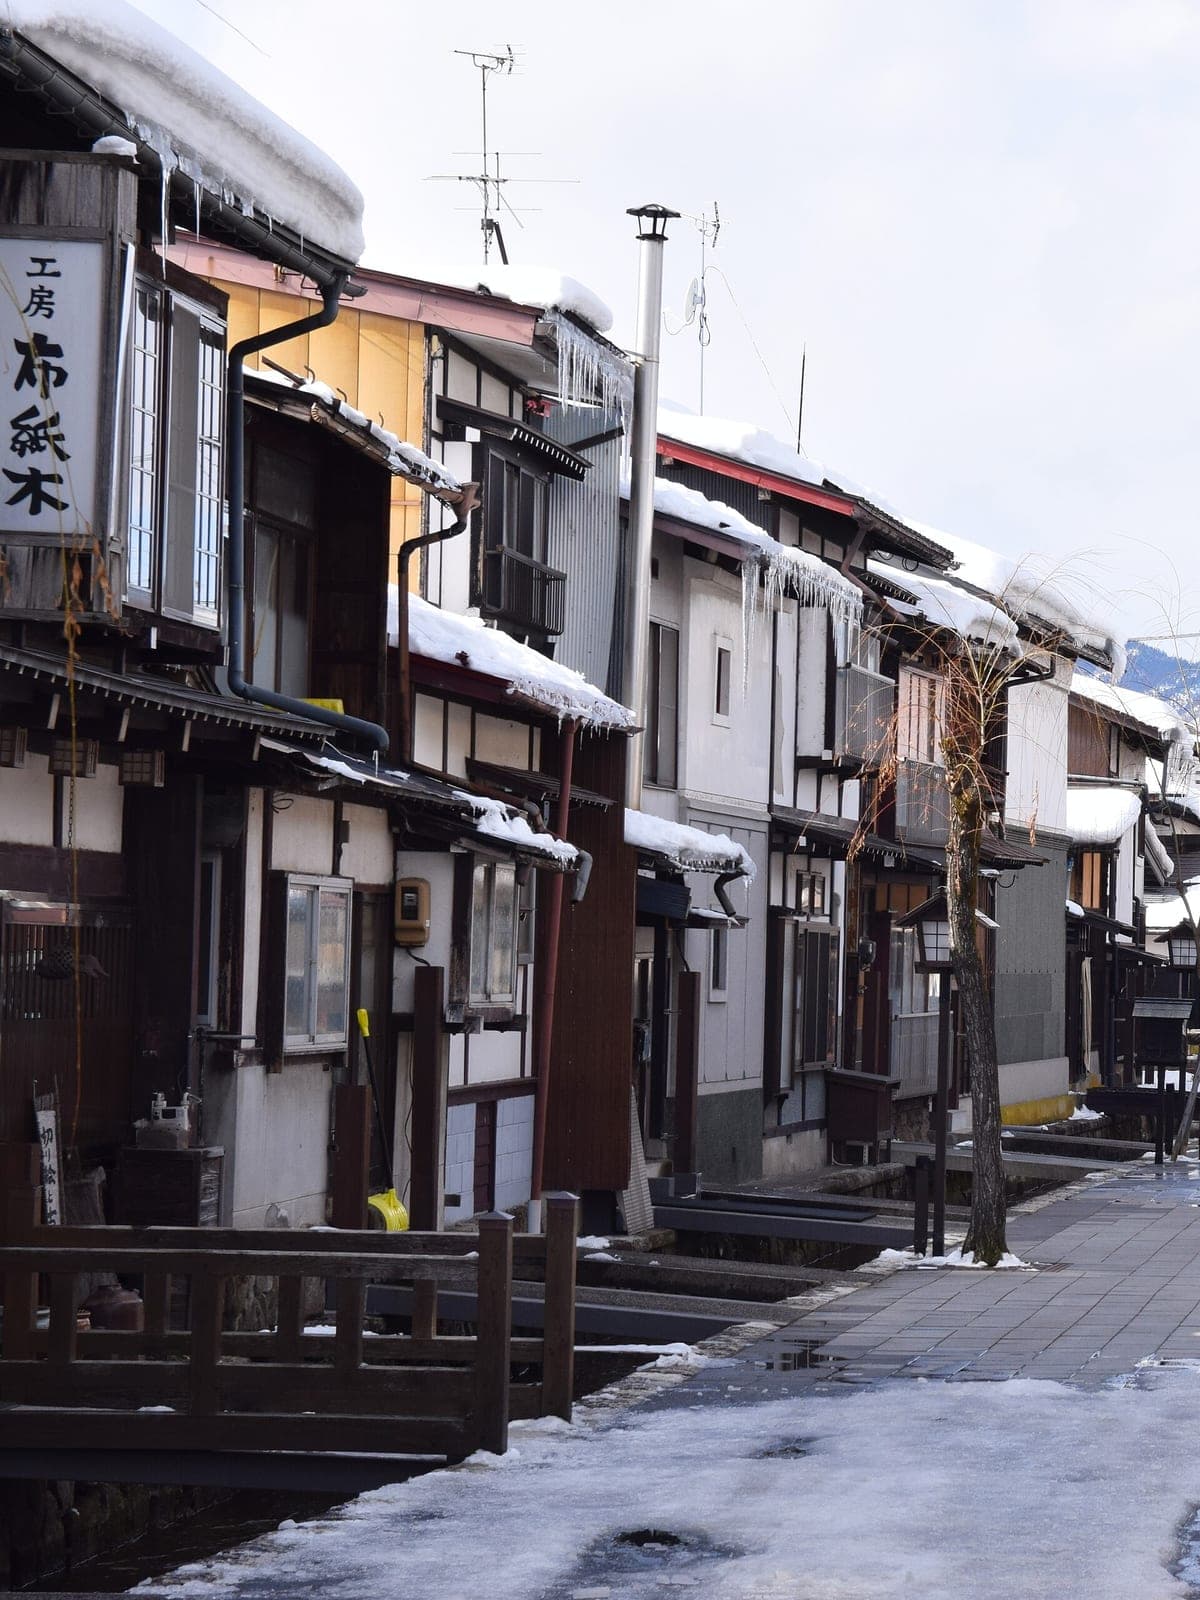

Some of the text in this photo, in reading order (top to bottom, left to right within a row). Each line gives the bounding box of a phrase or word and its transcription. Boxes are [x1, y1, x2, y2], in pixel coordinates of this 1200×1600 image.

[2, 256, 71, 515] 工房 布紙木
